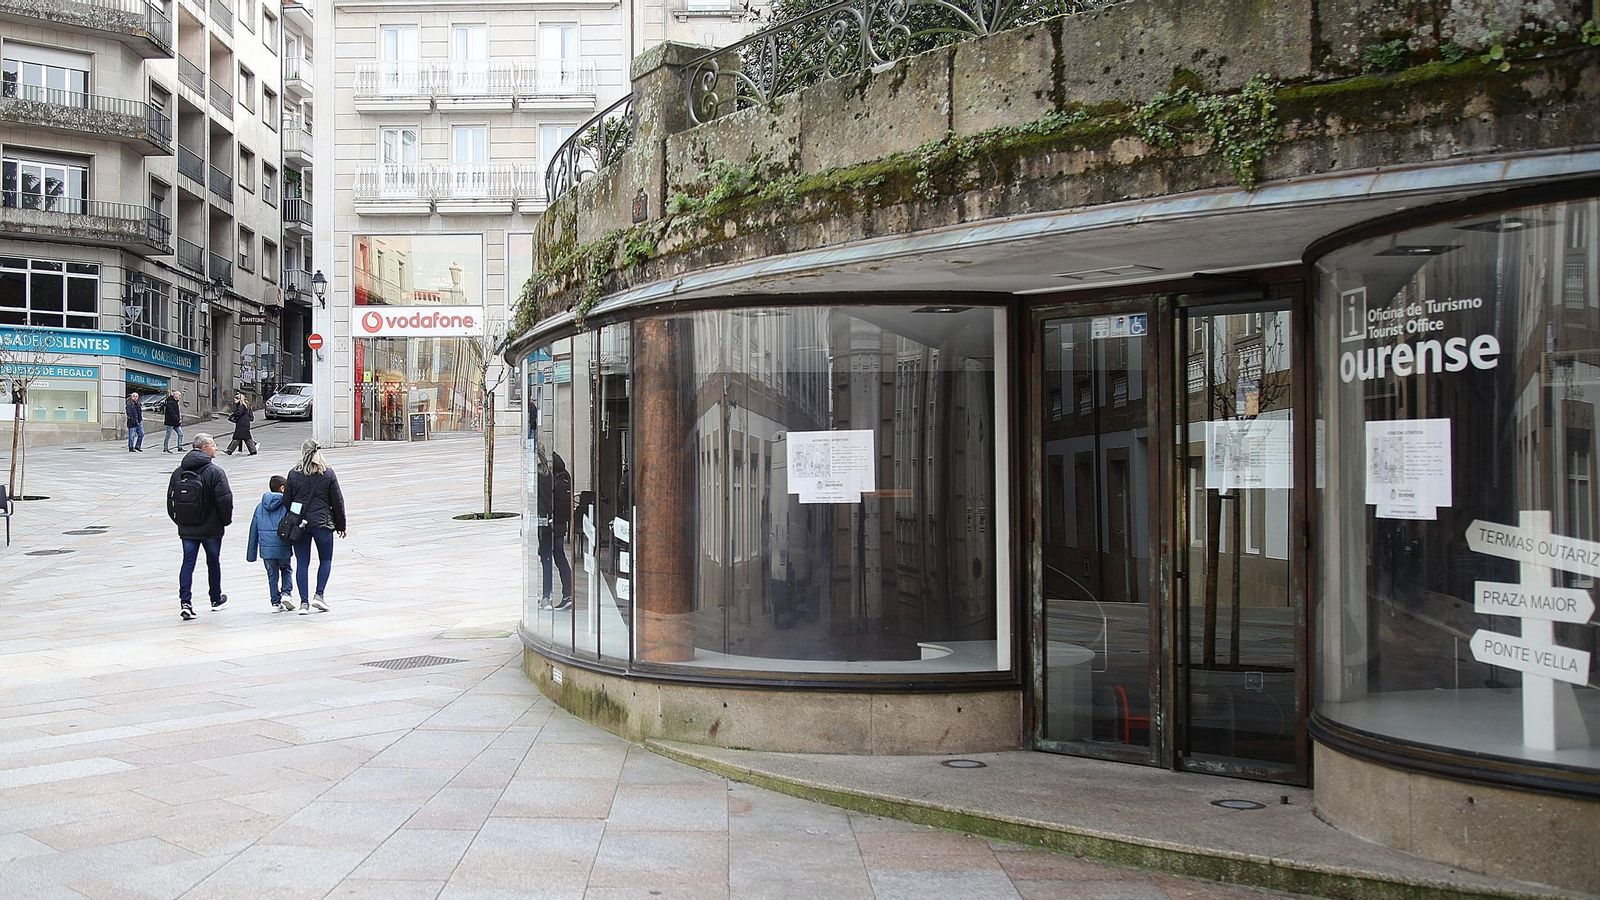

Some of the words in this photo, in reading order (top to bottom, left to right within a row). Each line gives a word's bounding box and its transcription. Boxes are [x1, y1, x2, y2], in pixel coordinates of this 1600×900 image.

[385, 312, 474, 329] vodafone
[1367, 306, 1404, 323] Oficina
[1406, 302, 1422, 316] de
[1425, 296, 1483, 314] Turismo
[1367, 323, 1404, 340] Tourist
[1406, 318, 1444, 334] Office
[1340, 334, 1501, 383] ourense
[43, 367, 54, 376] DE
[57, 368, 93, 377] REGALO
[1479, 527, 1534, 552] TERMAS
[1538, 541, 1600, 567] OUTARIZ
[1483, 590, 1528, 608] PRAZA
[1530, 595, 1577, 613] MAIOR
[1484, 639, 1530, 662] PONTE
[1534, 650, 1578, 673] VELLA
